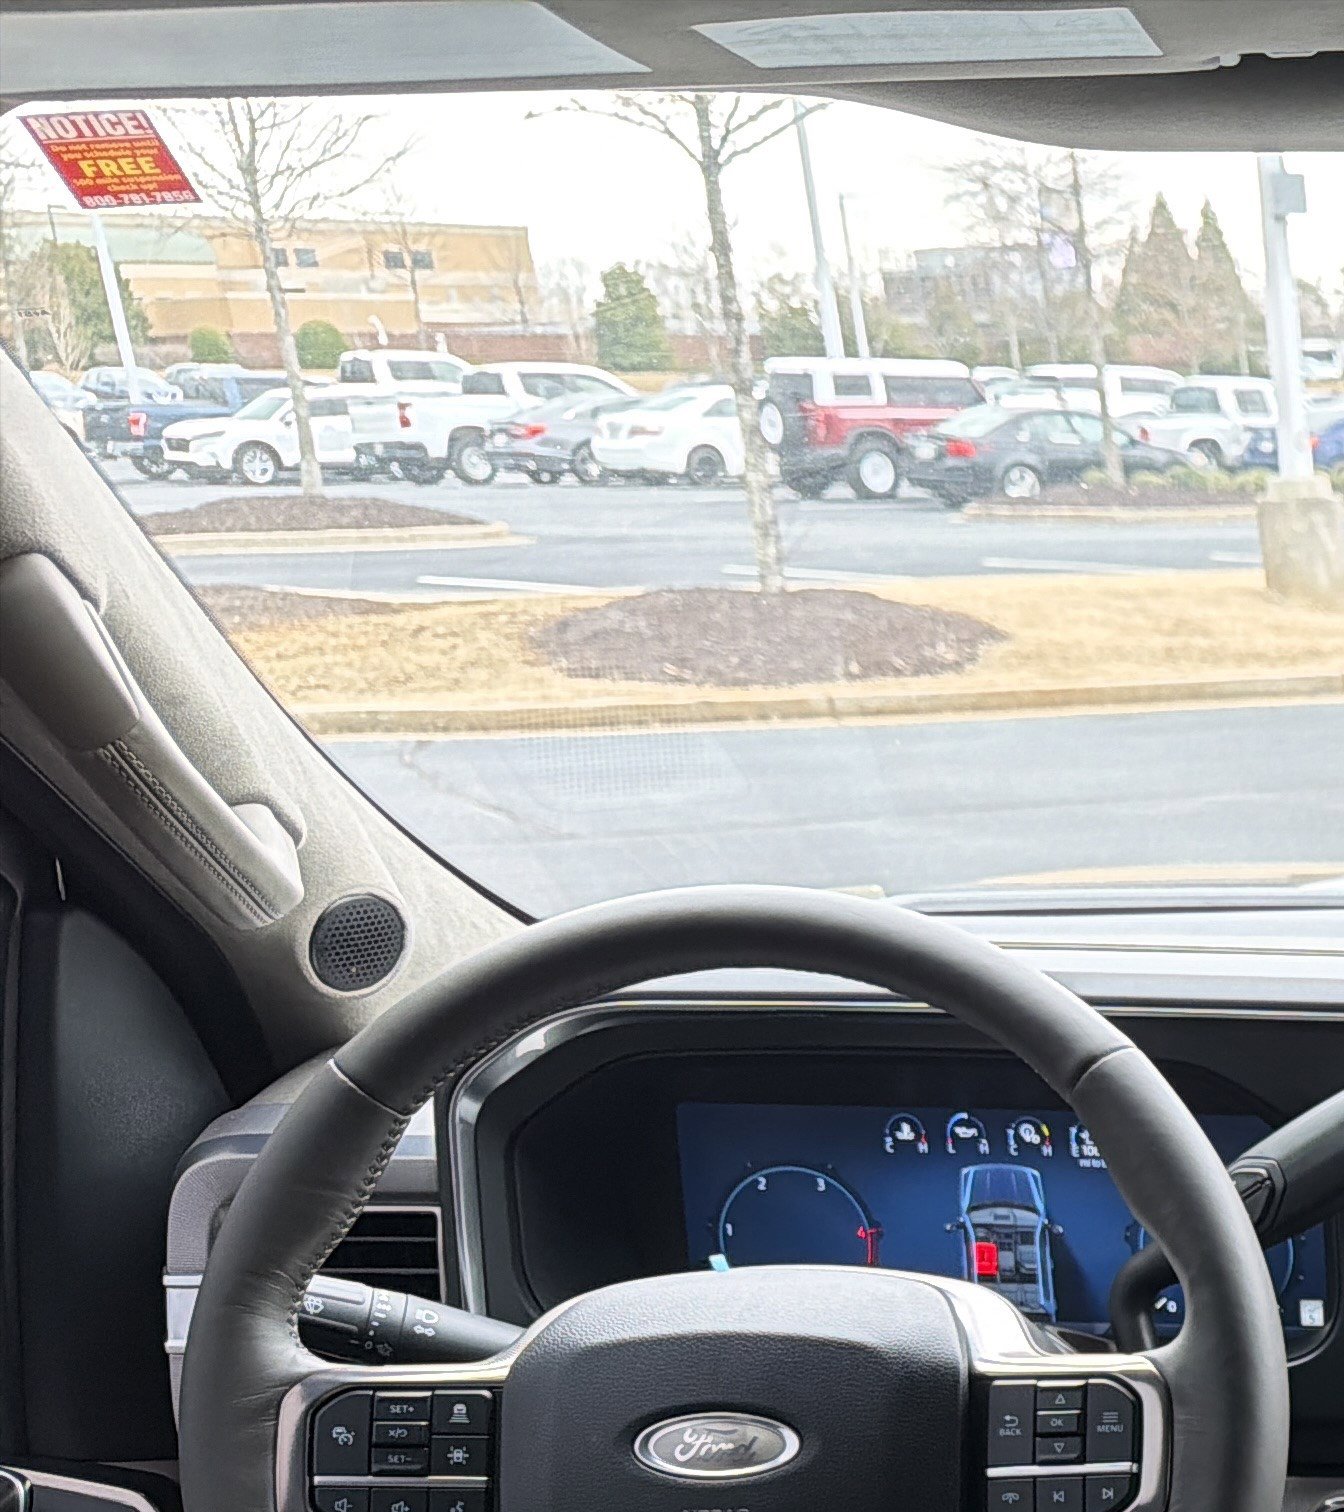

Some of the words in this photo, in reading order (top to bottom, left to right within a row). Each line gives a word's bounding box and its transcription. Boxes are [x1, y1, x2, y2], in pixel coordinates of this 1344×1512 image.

[27, 112, 153, 140] NOTICE!
[77, 156, 161, 177] FREE
[757, 1177, 766, 1192] 2
[817, 1177, 826, 1192] 3
[390, 1404, 414, 1414] SET+
[1050, 1418, 1064, 1427] OK
[1097, 1425, 1124, 1433] MENU
[999, 1428, 1022, 1436] BACK
[675, 1427, 759, 1462] Ford
